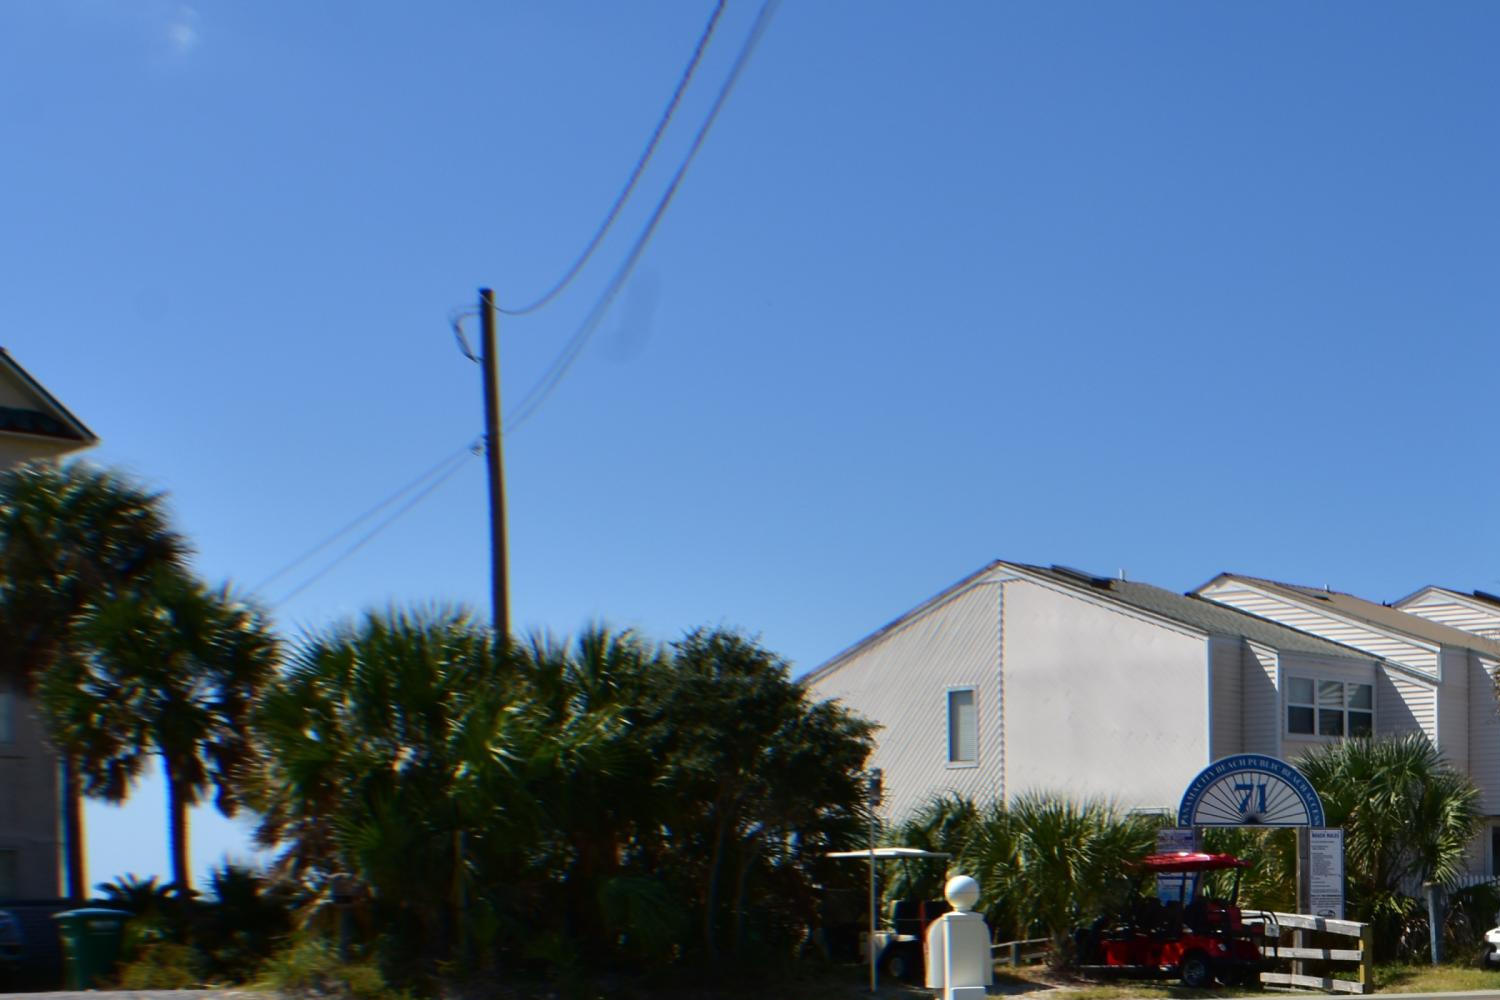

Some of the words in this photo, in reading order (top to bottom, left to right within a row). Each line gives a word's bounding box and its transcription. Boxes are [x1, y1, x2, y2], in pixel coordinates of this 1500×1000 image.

[1214, 759, 1244, 773] BEACH
[1248, 759, 1279, 770] PUBLIC
[1281, 767, 1307, 791] BEACH
[1305, 791, 1320, 825] ACCESS
[1235, 784, 1267, 814] 71
